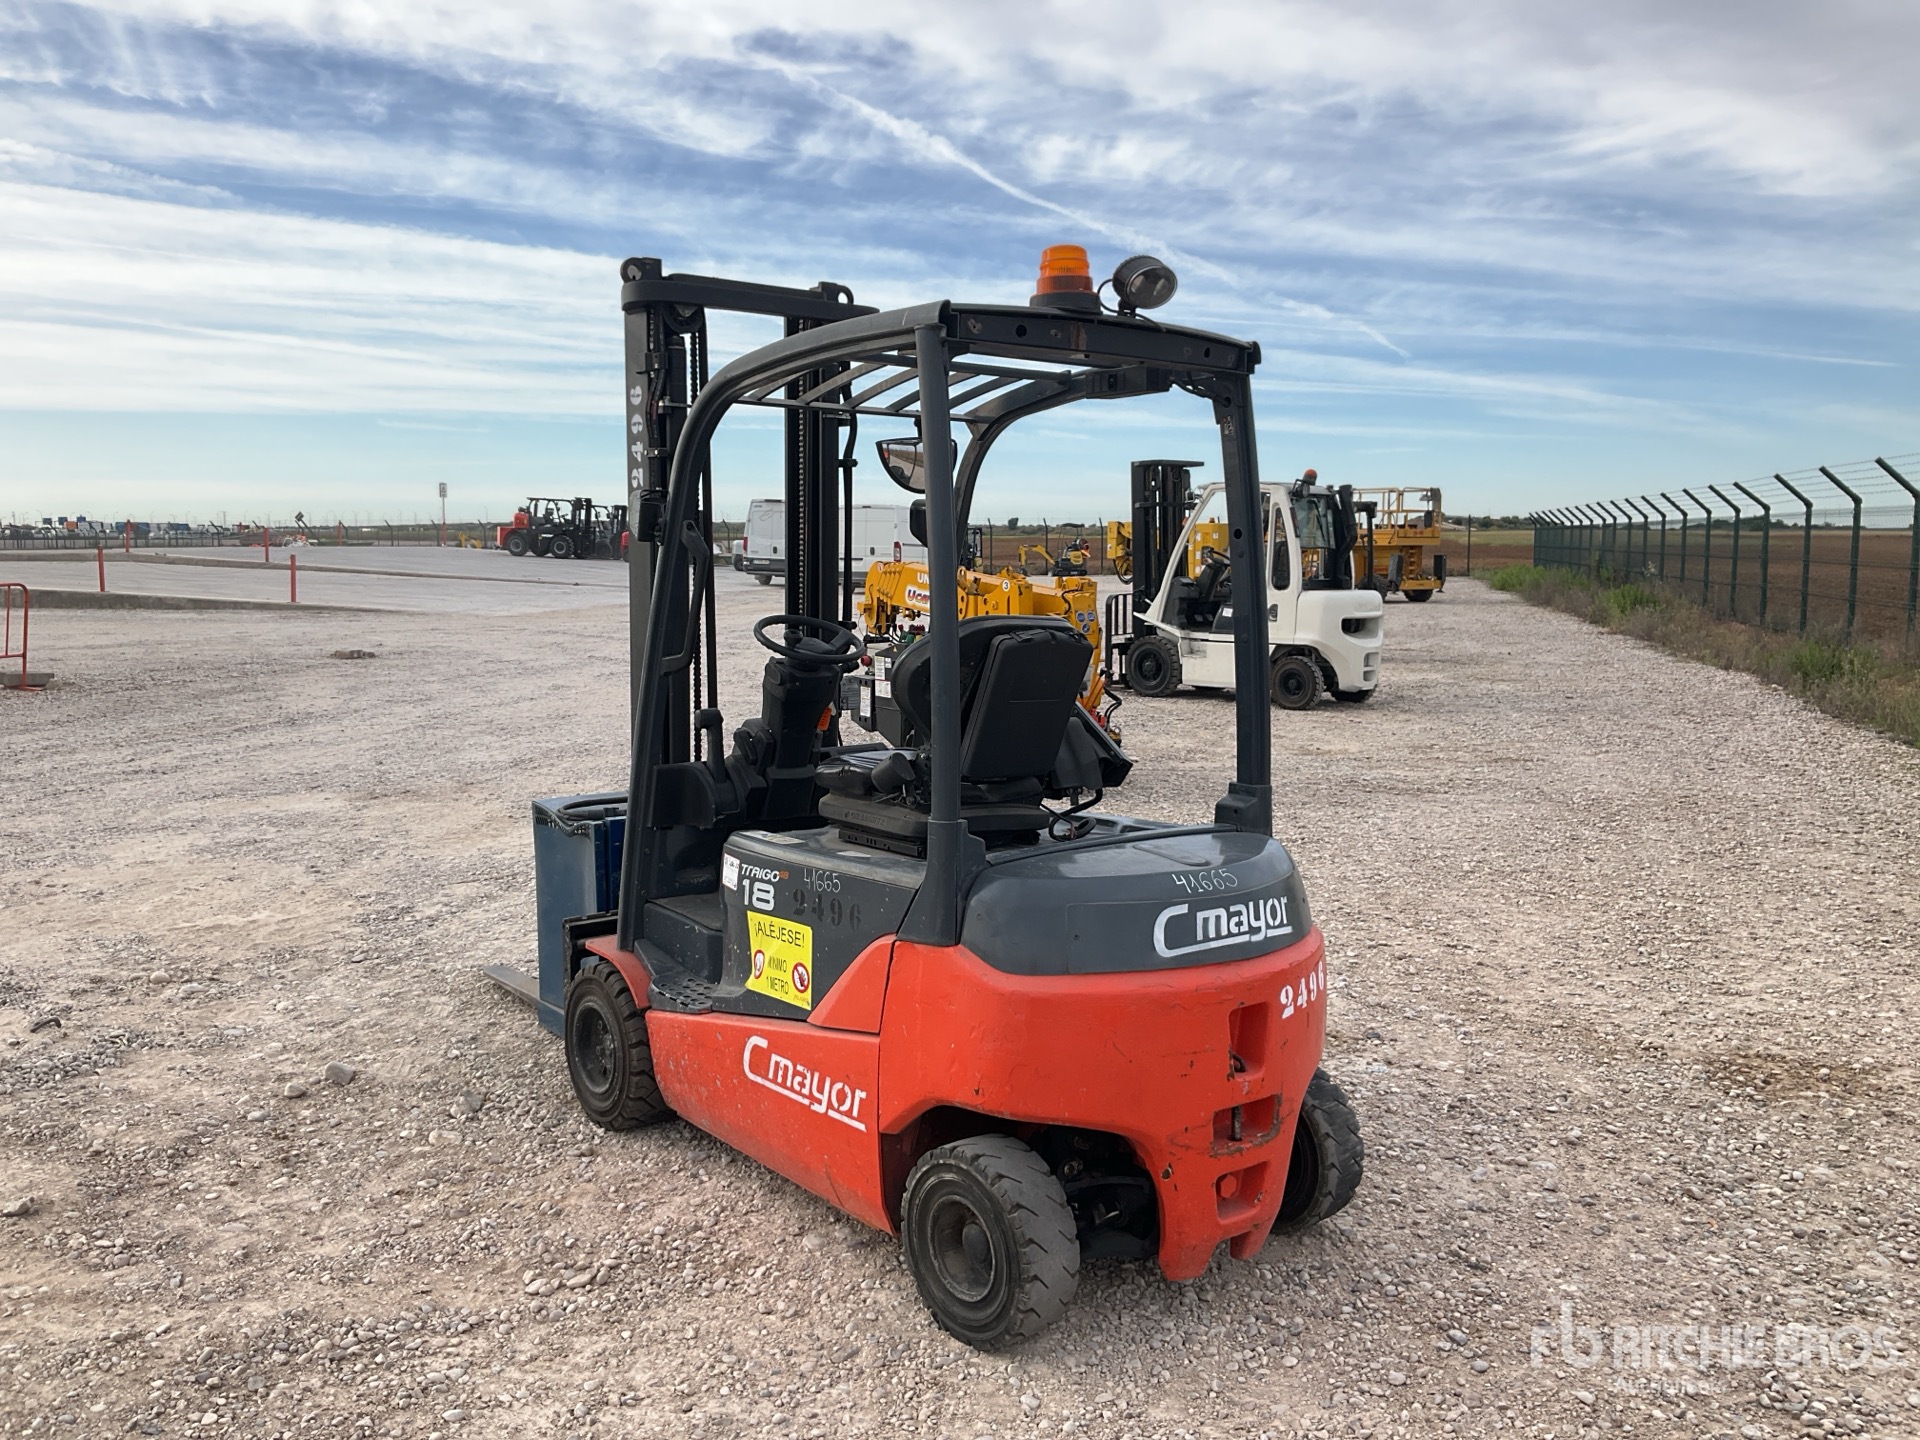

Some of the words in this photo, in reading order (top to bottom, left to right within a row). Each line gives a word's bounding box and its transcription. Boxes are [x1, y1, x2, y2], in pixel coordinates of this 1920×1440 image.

[630, 385, 644, 489] 2496
[742, 878, 775, 911] 18
[803, 867, 841, 893] 41665
[1171, 868, 1238, 894] 41665
[792, 888, 862, 932] 2496
[1279, 960, 1325, 1020] 2496
